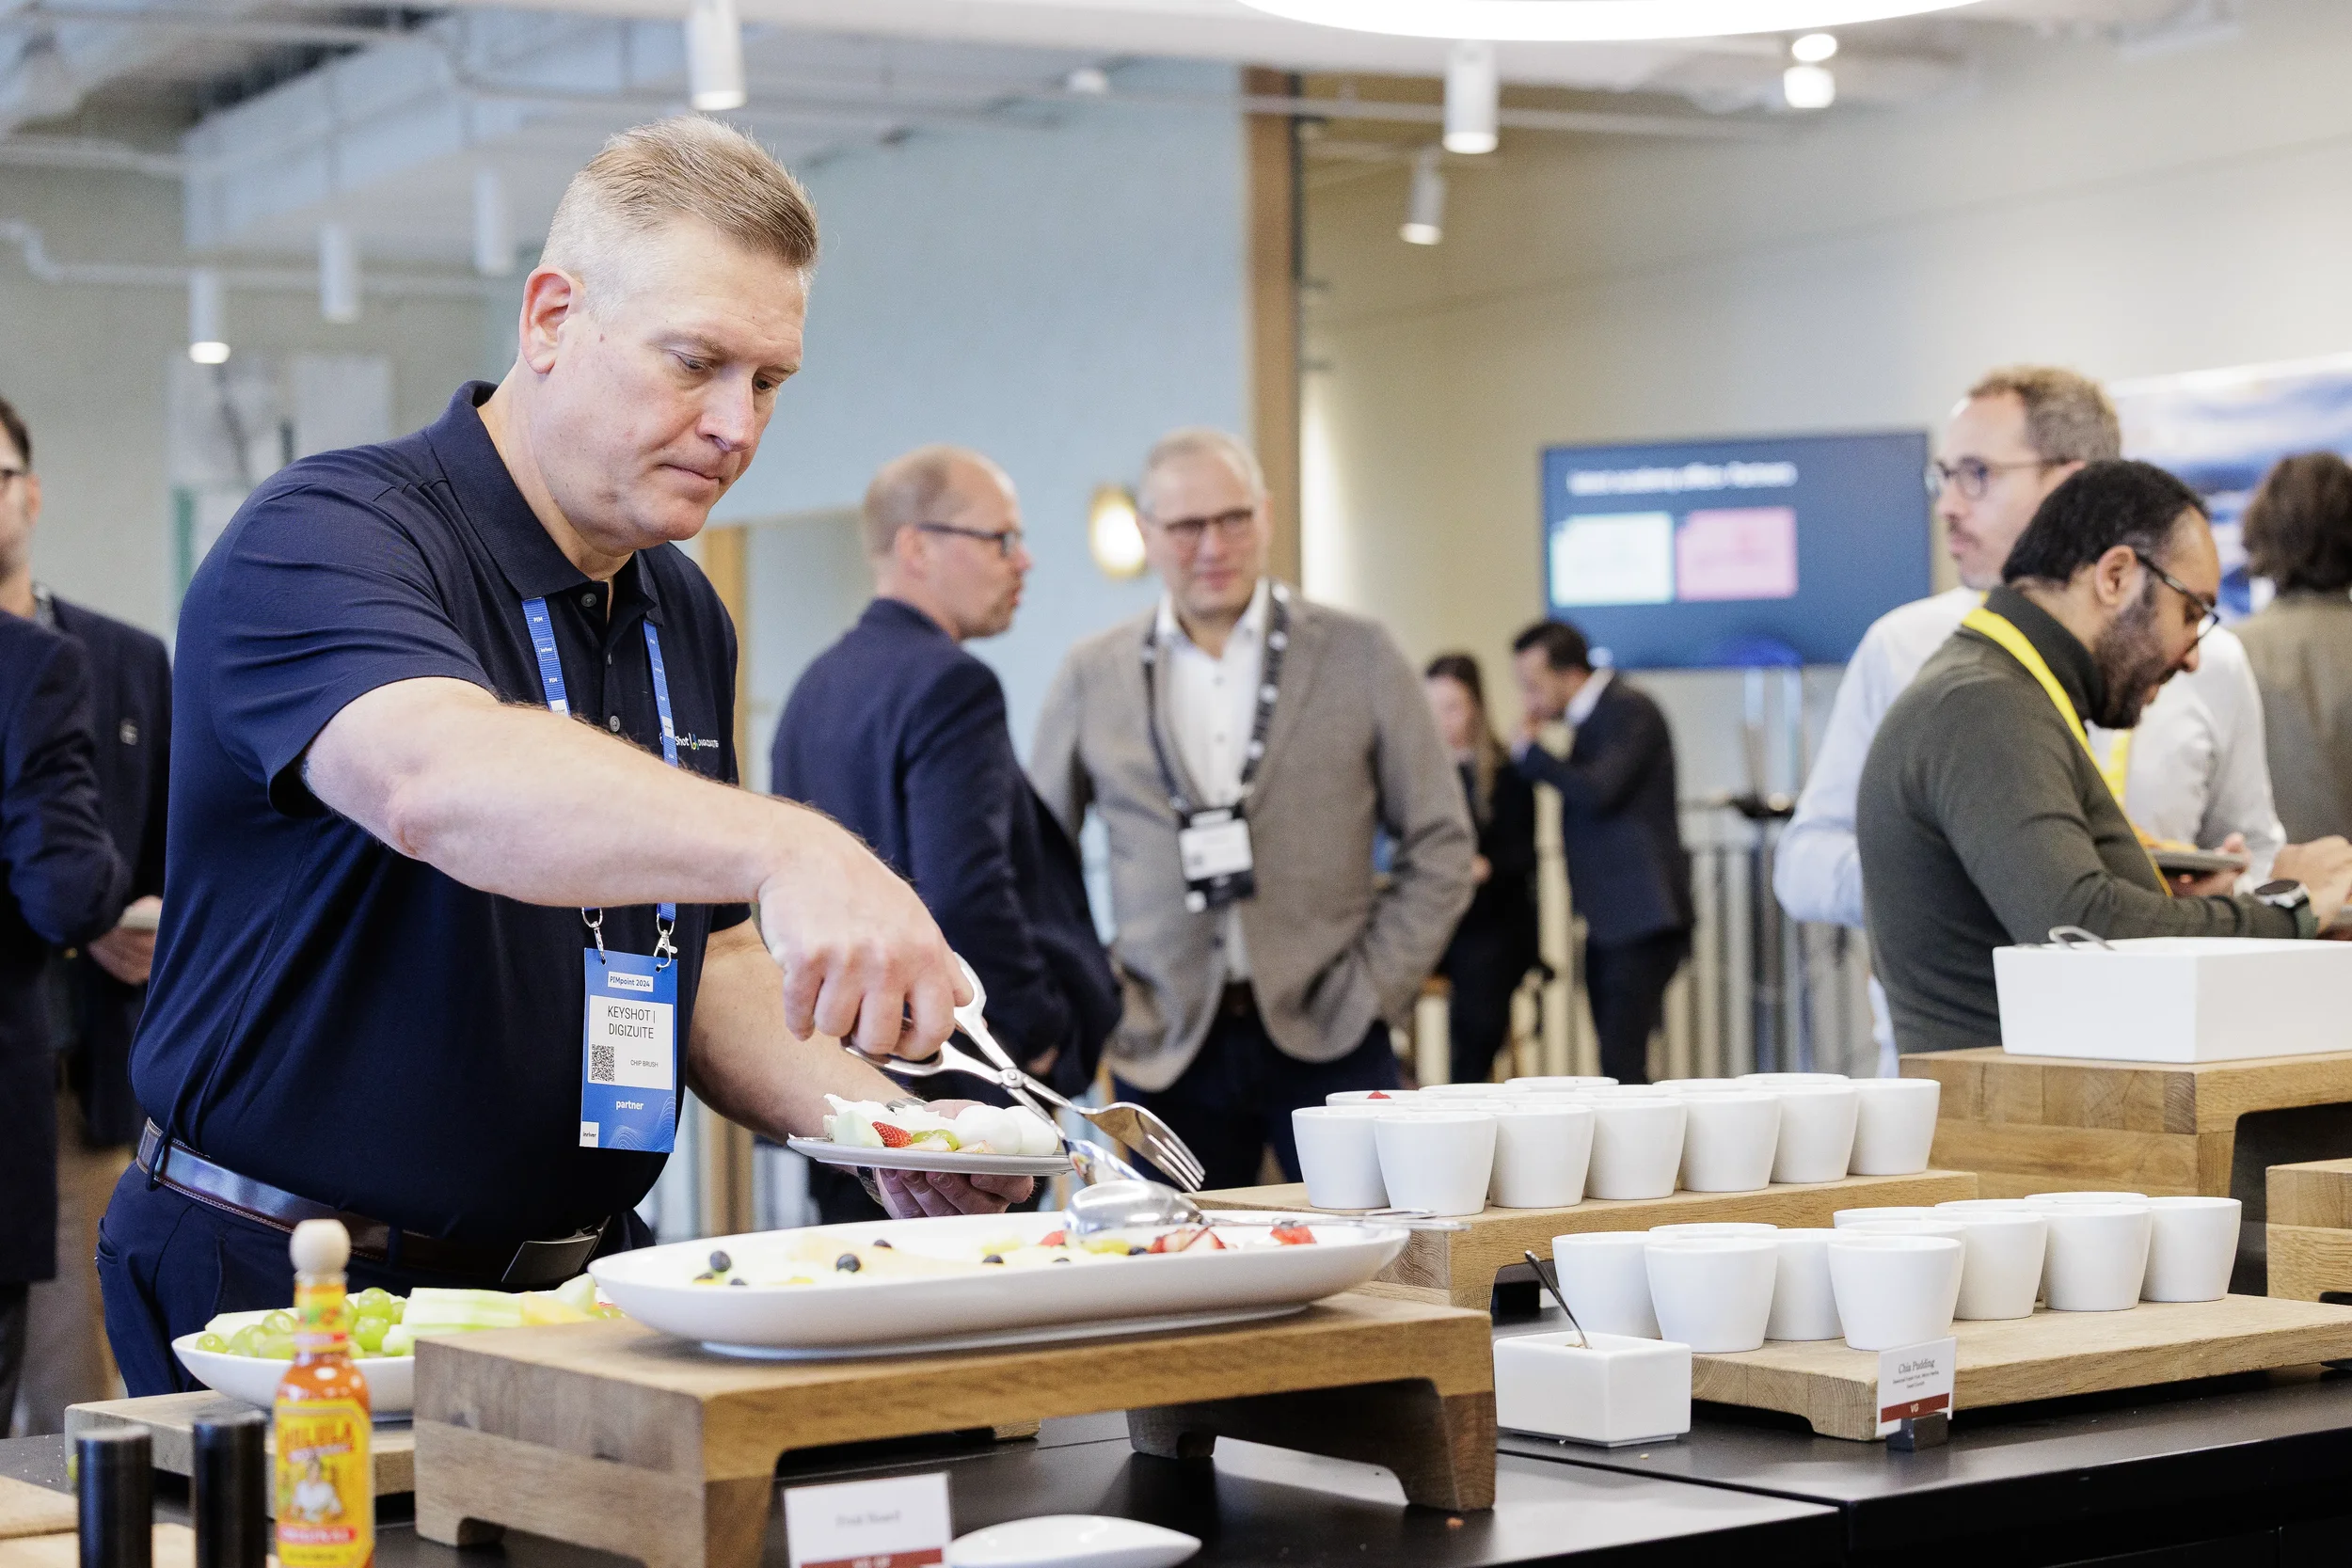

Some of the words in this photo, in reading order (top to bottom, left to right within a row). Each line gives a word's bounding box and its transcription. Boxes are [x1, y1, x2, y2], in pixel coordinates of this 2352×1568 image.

[610, 975, 635, 987] PIMpoint
[636, 979, 650, 988] 2024
[607, 1006, 651, 1022] KEYSHOT
[609, 1022, 654, 1039] DIGIZUITE
[629, 1059, 642, 1068] CHIP
[642, 1060, 659, 1069] BRUSH
[615, 1100, 644, 1111] partner
[1899, 1362, 1911, 1373] Chia
[1912, 1357, 1935, 1371] Pudding
